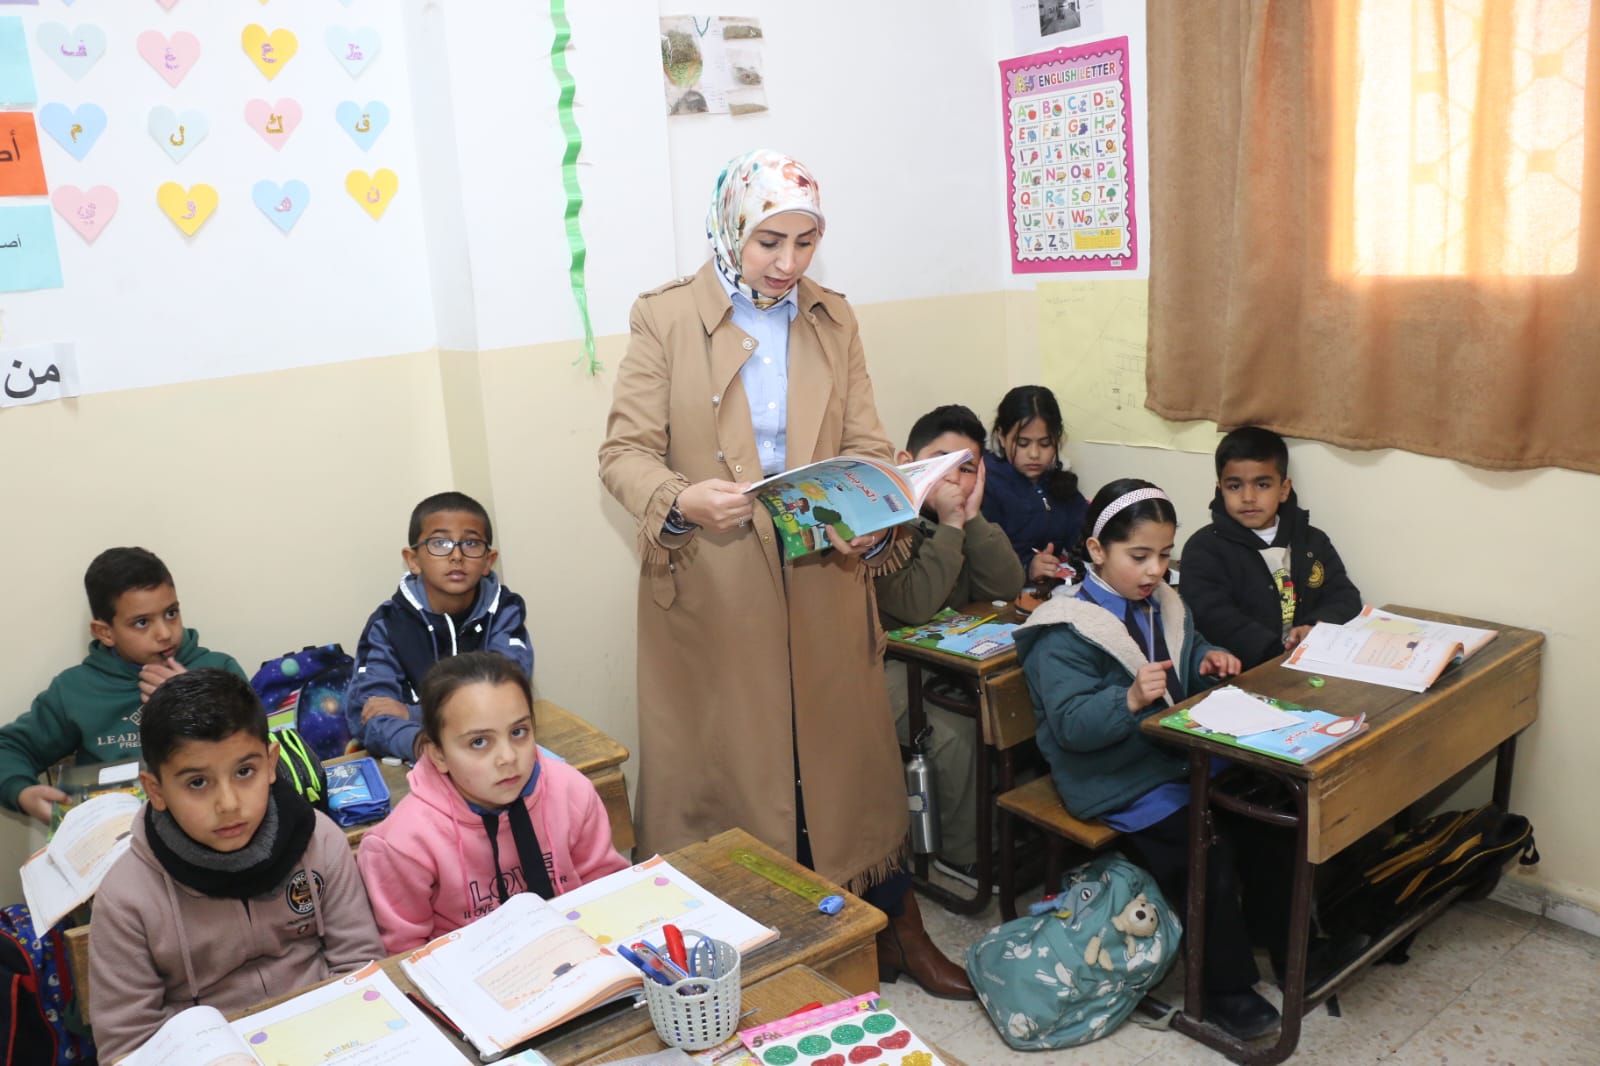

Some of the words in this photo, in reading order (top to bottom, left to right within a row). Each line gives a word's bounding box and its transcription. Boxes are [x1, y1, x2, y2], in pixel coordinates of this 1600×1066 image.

[261, 43, 278, 63] ع
[1039, 69, 1077, 87] ENGLISH
[1080, 62, 1115, 80] LETTER
[1018, 105, 1027, 118] A
[1042, 100, 1051, 114] B
[1067, 96, 1077, 110] C
[1093, 92, 1103, 107] D
[70, 123, 83, 143] م
[355, 114, 370, 133] ق
[1019, 127, 1025, 140] E
[1043, 123, 1049, 136] F
[1068, 119, 1078, 133] G
[1095, 116, 1104, 129] H
[170, 125, 185, 146] ل
[1020, 150, 1024, 162] I
[1046, 145, 1051, 159] J
[1070, 143, 1079, 156] K
[1096, 139, 1102, 153] L
[1021, 170, 1032, 184] M
[1046, 168, 1055, 181] N
[1071, 165, 1080, 179] O
[1097, 162, 1105, 176] P
[366, 185, 380, 204] ن
[1021, 192, 1031, 206] Q
[1046, 190, 1054, 203] R
[1072, 187, 1079, 201] S
[1098, 185, 1105, 198] T
[180, 200, 196, 220] و
[1023, 213, 1032, 227] U
[1045, 212, 1054, 225] V
[1072, 210, 1085, 223] W
[1098, 208, 1107, 222] X
[1024, 236, 1032, 248] Y
[1047, 234, 1056, 247] Z
[4, 359, 60, 398] من
